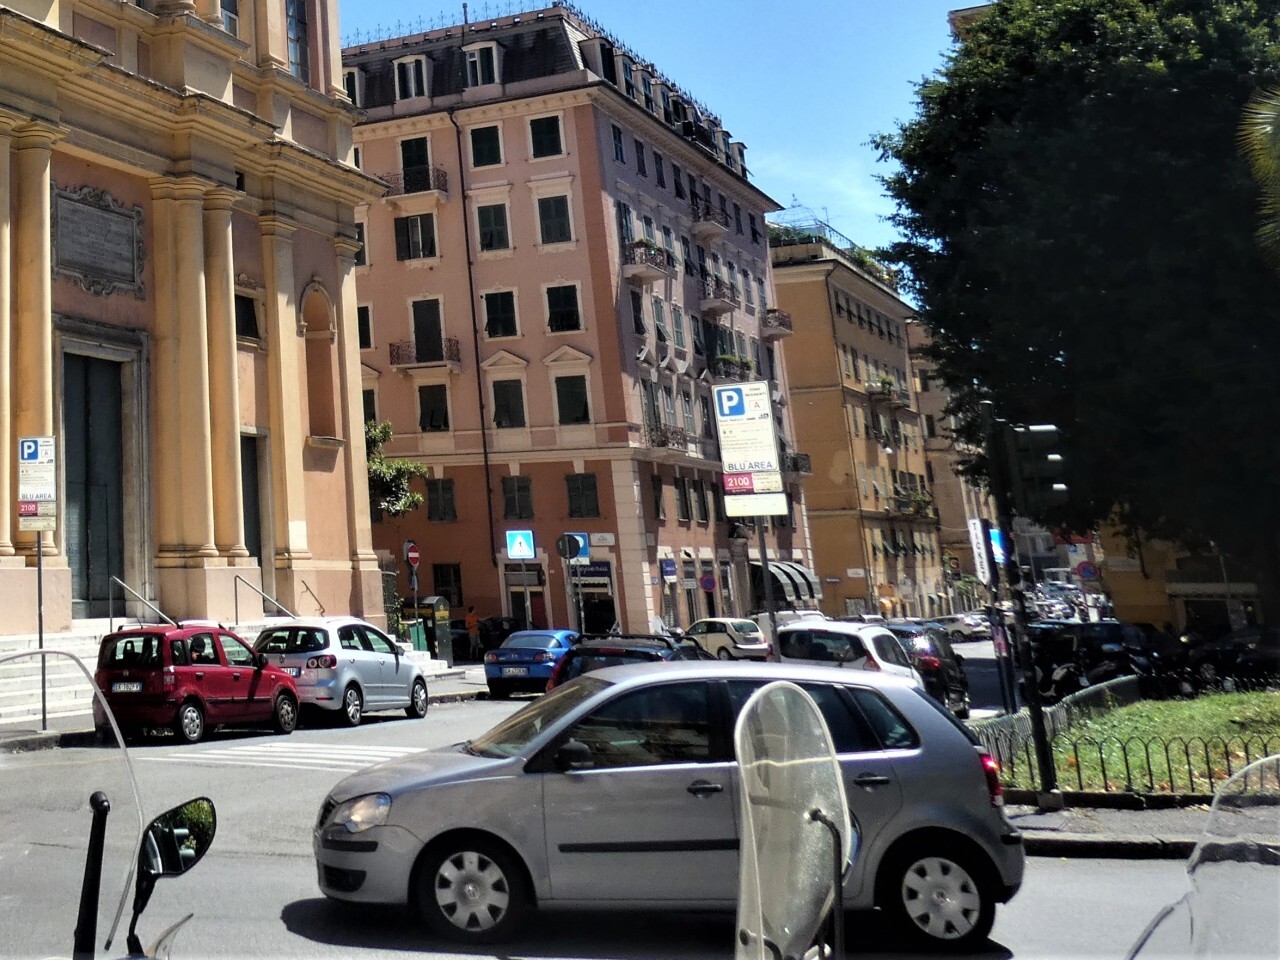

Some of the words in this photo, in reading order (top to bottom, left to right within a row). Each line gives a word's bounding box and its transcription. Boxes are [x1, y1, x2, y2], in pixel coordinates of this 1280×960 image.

[721, 391, 739, 414] P
[23, 442, 35, 458] P
[728, 463, 746, 471] BLU
[748, 461, 773, 470] AREA
[727, 477, 749, 487] 2100
[972, 522, 986, 579] TICKET
